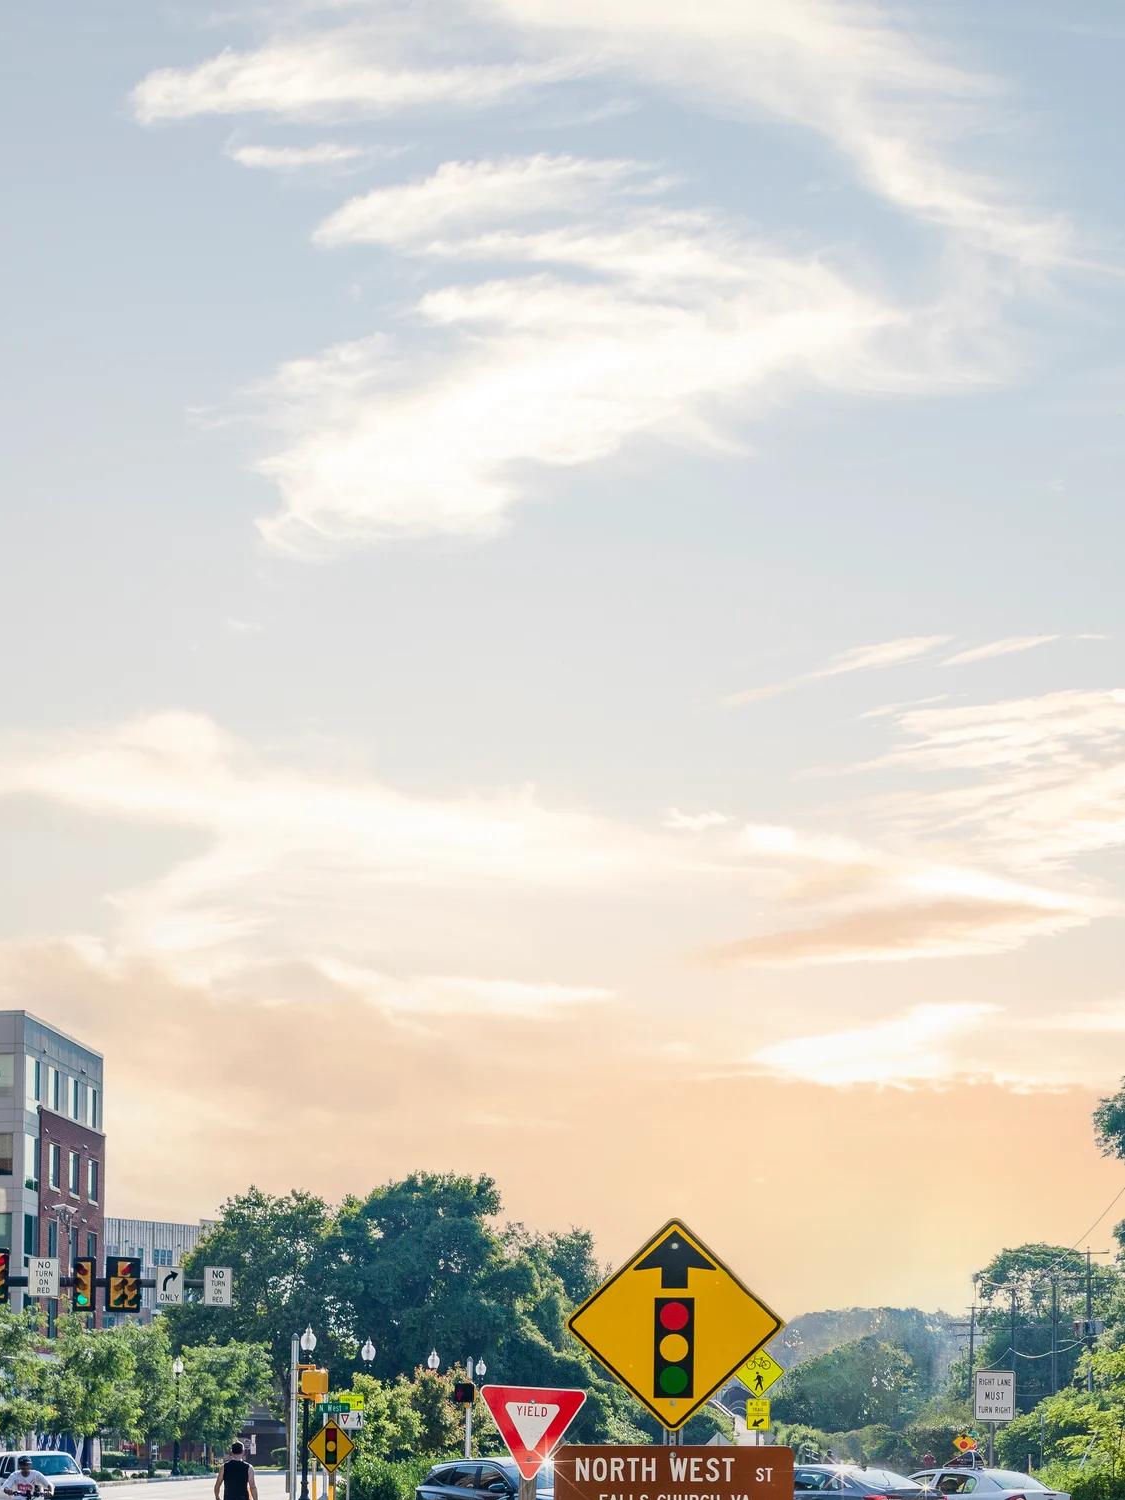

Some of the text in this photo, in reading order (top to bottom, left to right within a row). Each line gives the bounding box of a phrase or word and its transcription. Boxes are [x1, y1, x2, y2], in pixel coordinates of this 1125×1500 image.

[37, 1261, 51, 1269] NO
[212, 1270, 225, 1279] NO
[159, 1293, 180, 1302] ONLY
[979, 1378, 995, 1386] RIGHT
[985, 1392, 1004, 1400] MUST
[319, 1404, 324, 1412] N
[327, 1404, 342, 1412] West
[515, 1405, 549, 1418] YIELD
[995, 1406, 1011, 1414] RIGHT
[574, 1457, 774, 1482] NORTH WEST ST
